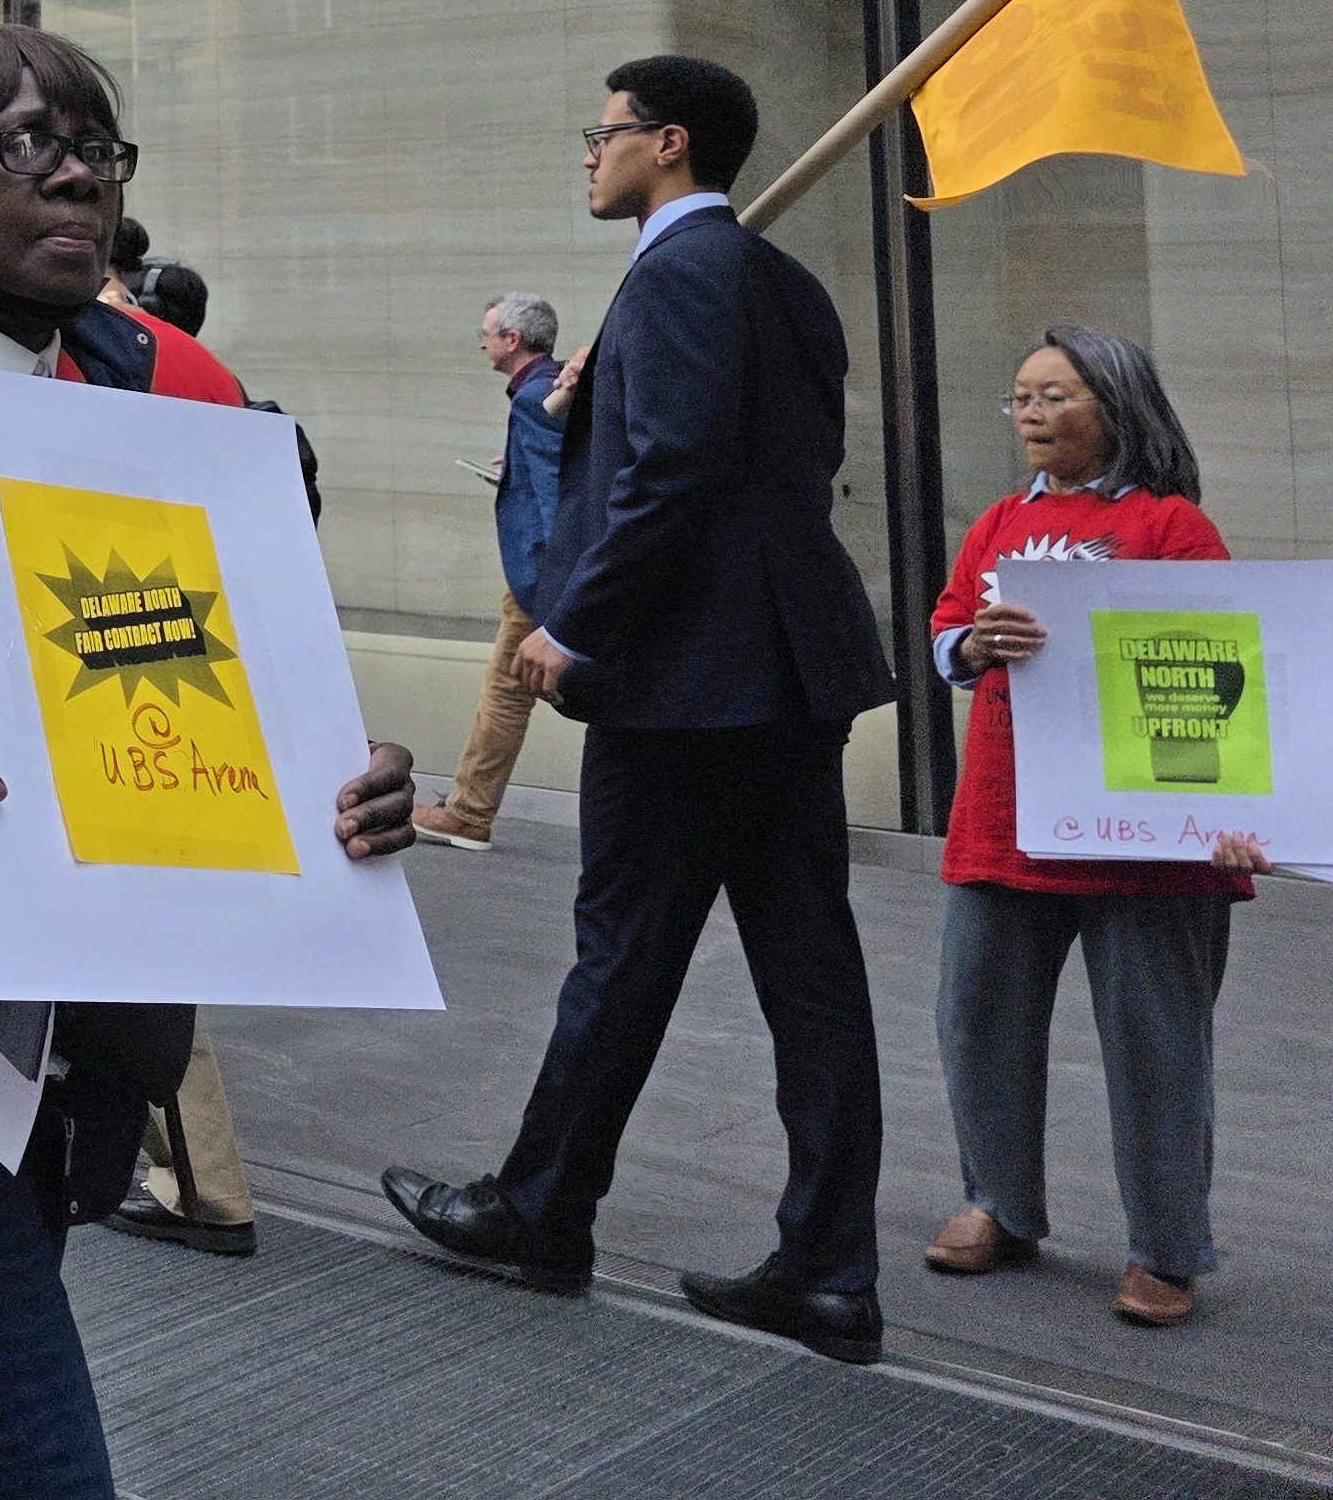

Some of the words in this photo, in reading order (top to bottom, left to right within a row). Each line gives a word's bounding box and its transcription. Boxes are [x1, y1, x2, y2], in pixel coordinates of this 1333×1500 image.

[80, 591, 144, 619] DELAWARE
[143, 586, 183, 612] NORTH
[74, 630, 104, 654] FAIR
[104, 621, 162, 651] CONTRACT
[162, 617, 197, 642] NOW!
[1119, 637, 1239, 662] DELAWARE
[1140, 665, 1215, 688] NORTH
[1144, 704, 1179, 713] more
[1181, 704, 1227, 715] money
[1145, 694, 1166, 702] we
[132, 702, 181, 750] @
[1132, 715, 1231, 740] UPFRONT
[100, 742, 179, 791] UBS
[1053, 815, 1084, 841] @
[1096, 816, 1157, 843] UBS
